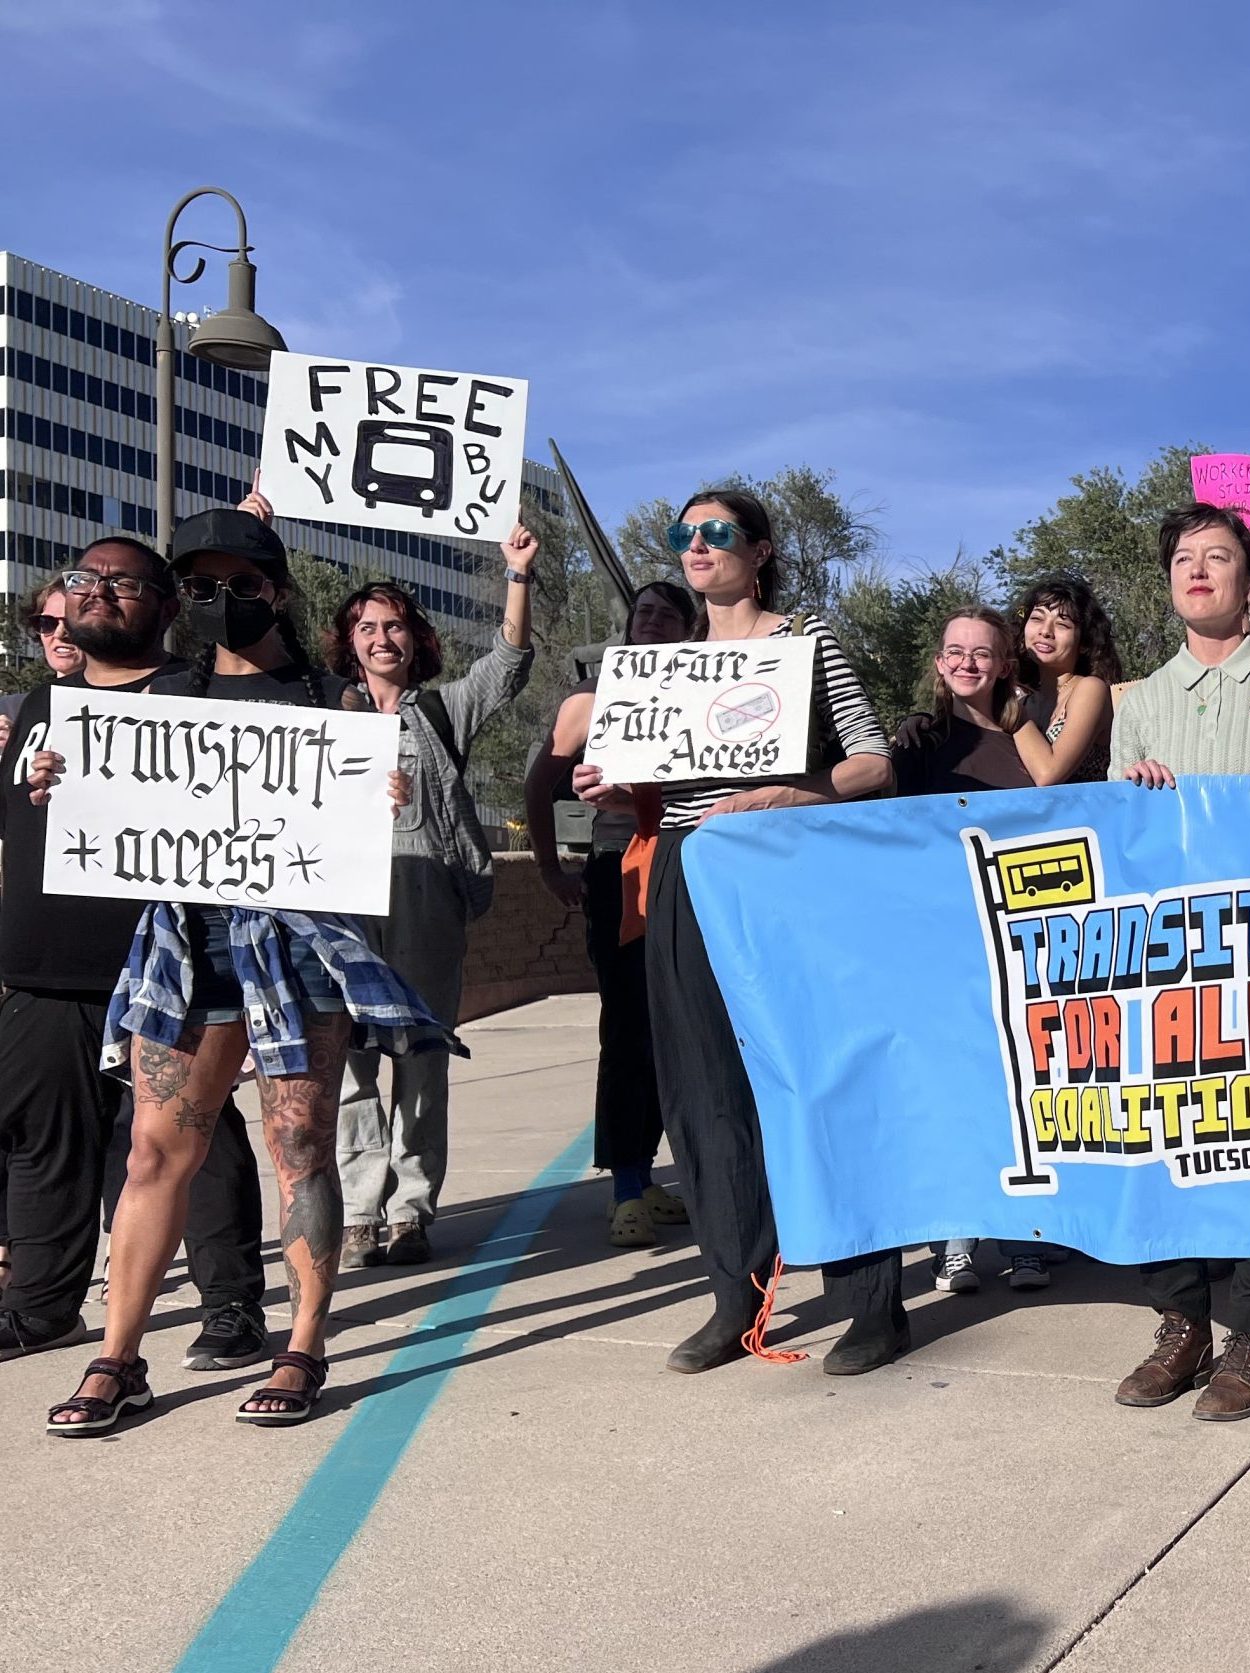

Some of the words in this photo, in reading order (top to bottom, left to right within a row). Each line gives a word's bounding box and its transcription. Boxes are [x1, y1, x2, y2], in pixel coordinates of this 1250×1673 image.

[309, 365, 514, 438] FREE
[285, 421, 341, 504] MY
[455, 443, 507, 535] BUS
[589, 696, 684, 750] Fair
[653, 728, 782, 779] Access
[1026, 994, 1121, 1085] FOR
